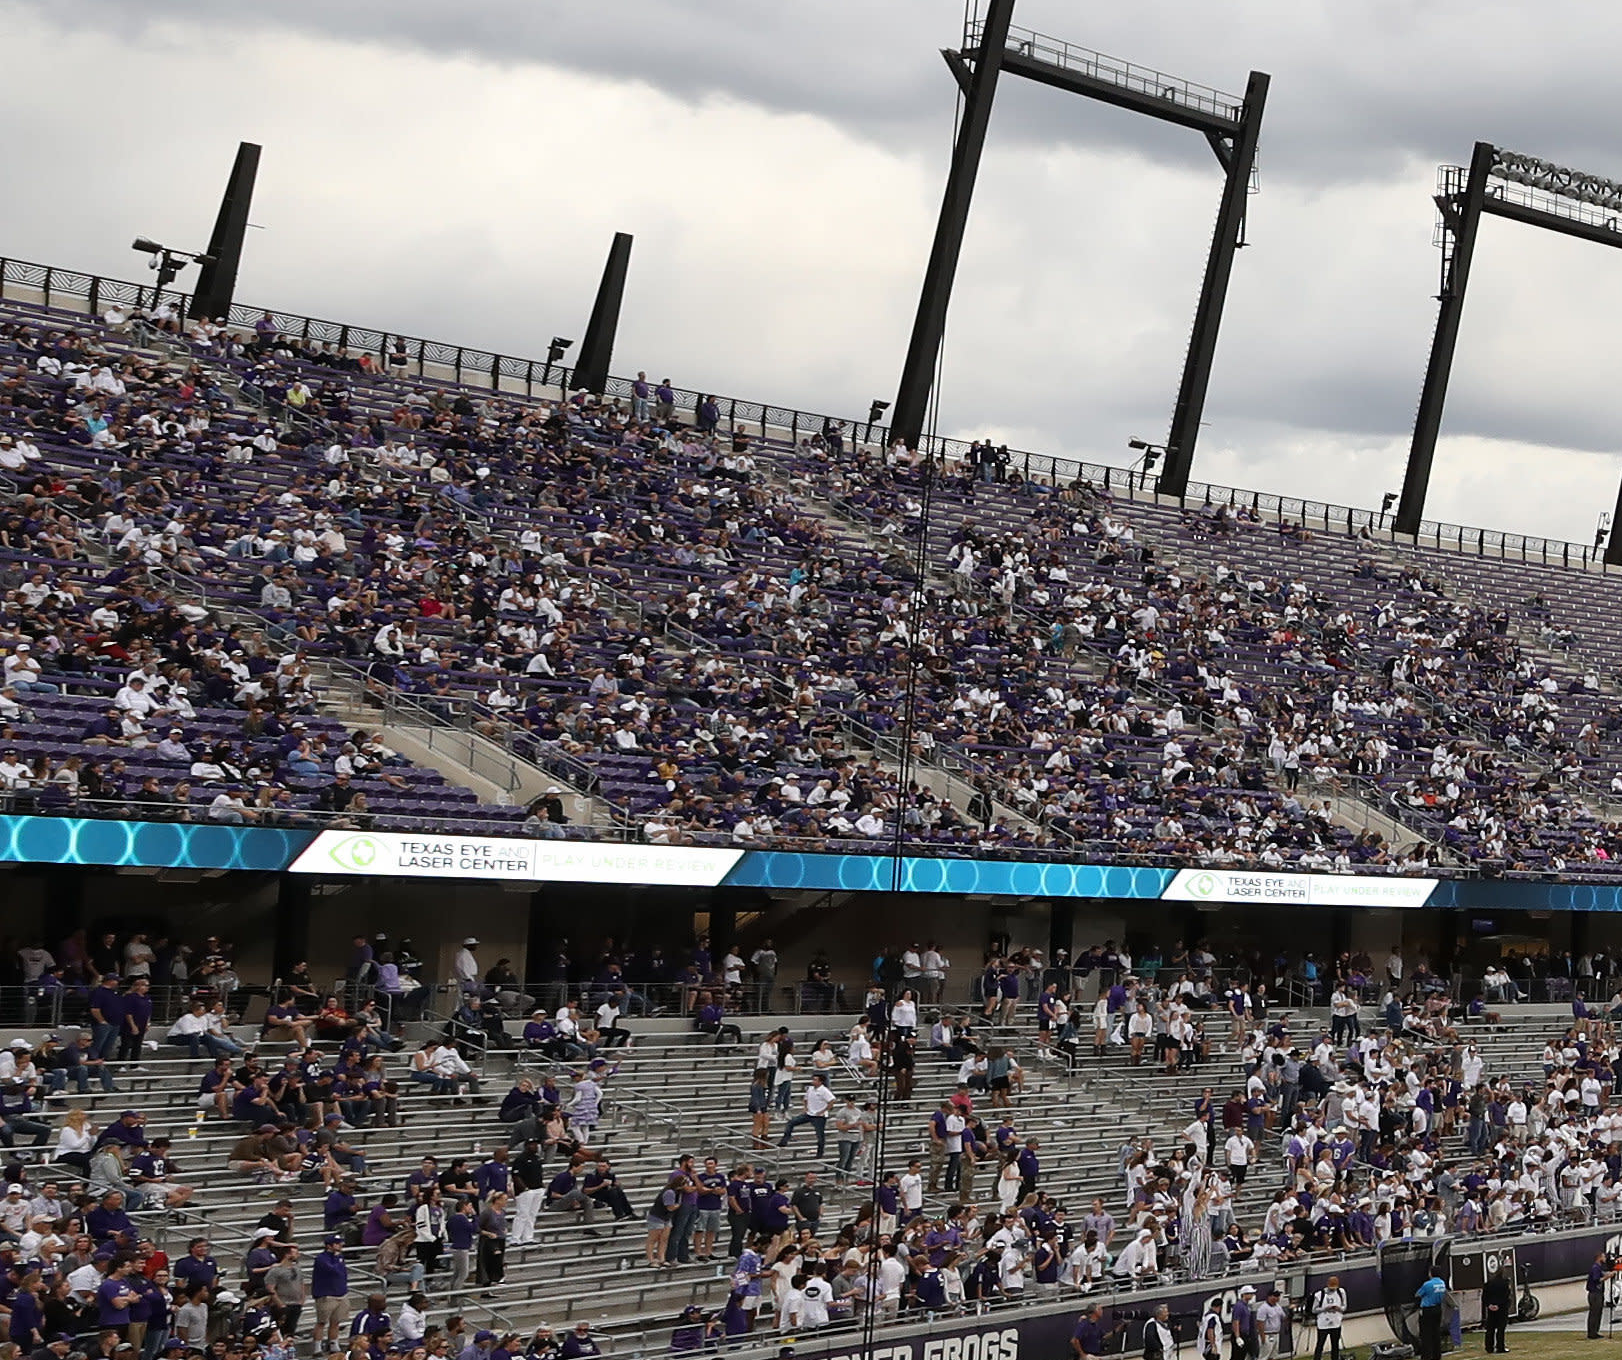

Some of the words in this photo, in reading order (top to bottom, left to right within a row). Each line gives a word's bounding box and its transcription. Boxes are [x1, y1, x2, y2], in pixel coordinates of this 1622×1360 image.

[400, 842, 454, 855] TEXAS
[460, 844, 492, 857] EYE
[399, 856, 453, 870] LASER
[459, 857, 528, 872] CENTER
[1228, 877, 1262, 887] TEXAS
[1265, 878, 1284, 888] EYE
[1227, 887, 1262, 897] LASER
[1265, 889, 1305, 898] CENTER
